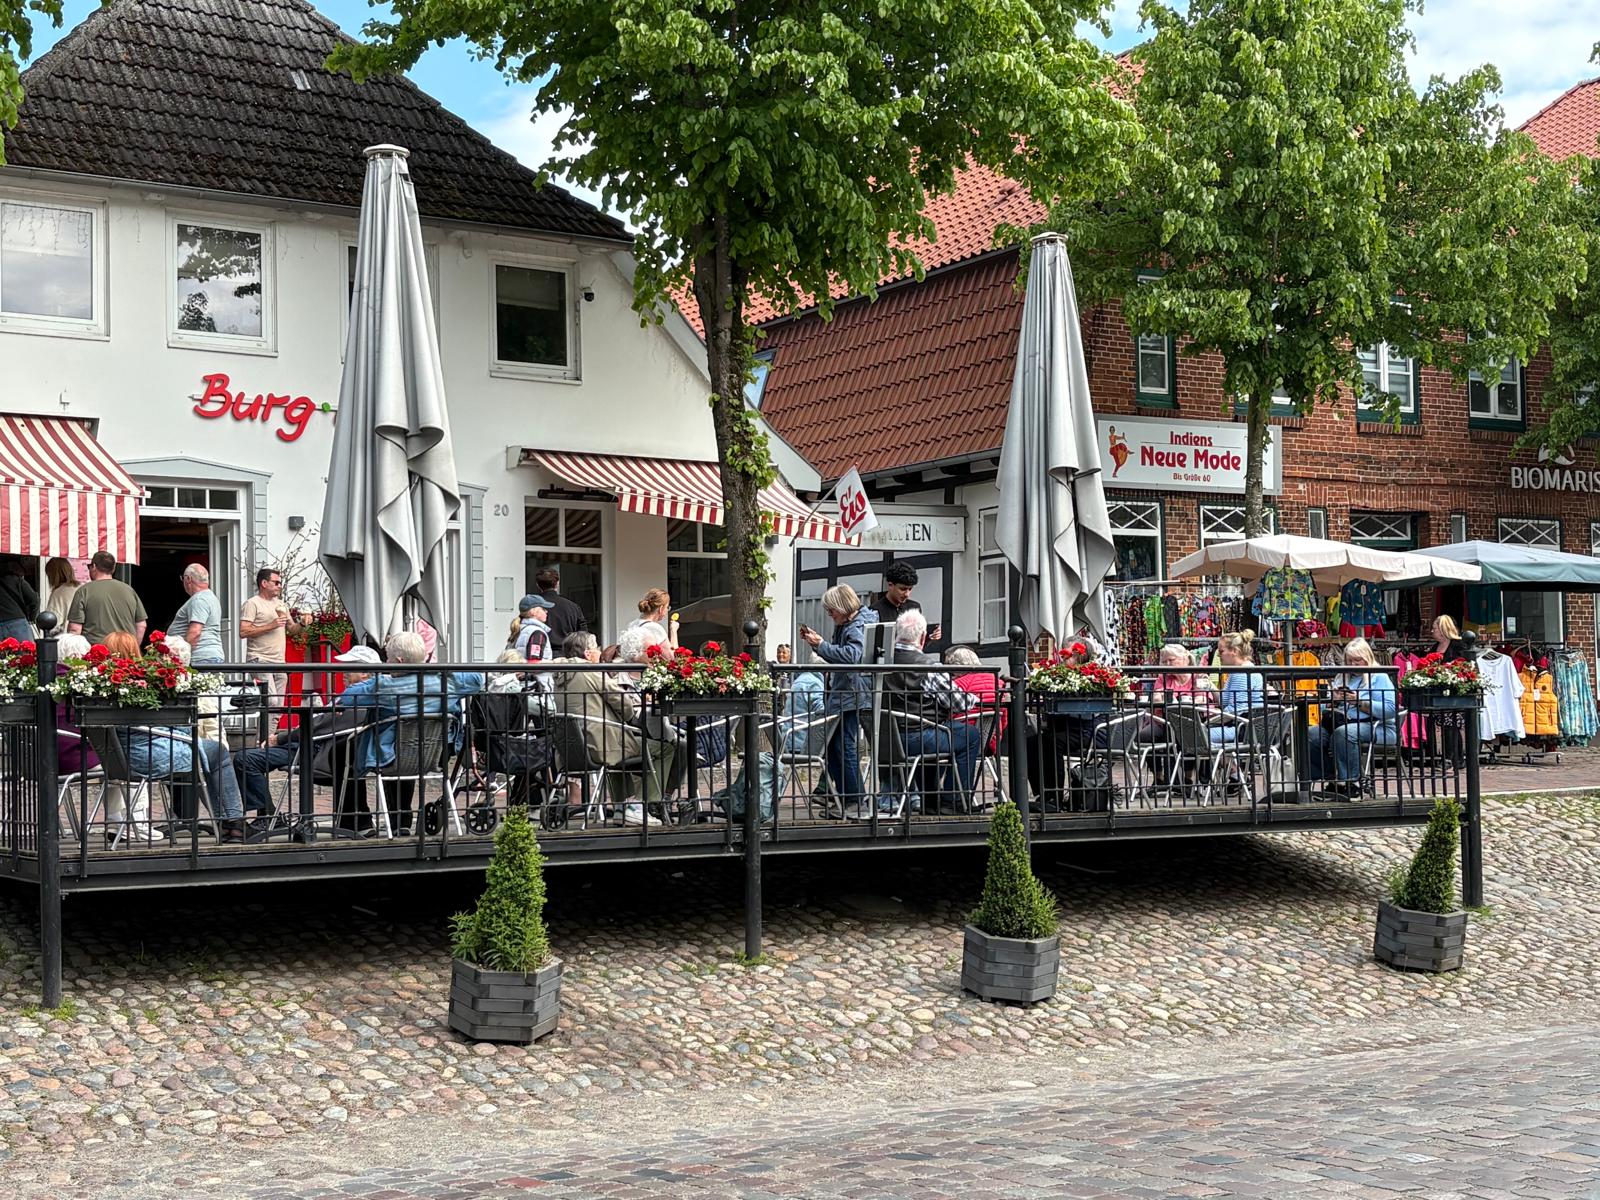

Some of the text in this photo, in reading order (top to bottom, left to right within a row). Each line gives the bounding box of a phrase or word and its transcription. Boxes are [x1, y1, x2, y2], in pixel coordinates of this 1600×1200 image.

[194, 373, 316, 442] Burg
[1170, 431, 1212, 446] Indiens
[1141, 446, 1241, 471] Neue Mode
[1511, 466, 1600, 492] BIOMARIS
[494, 504, 509, 516] 20
[840, 486, 865, 529] Eis
